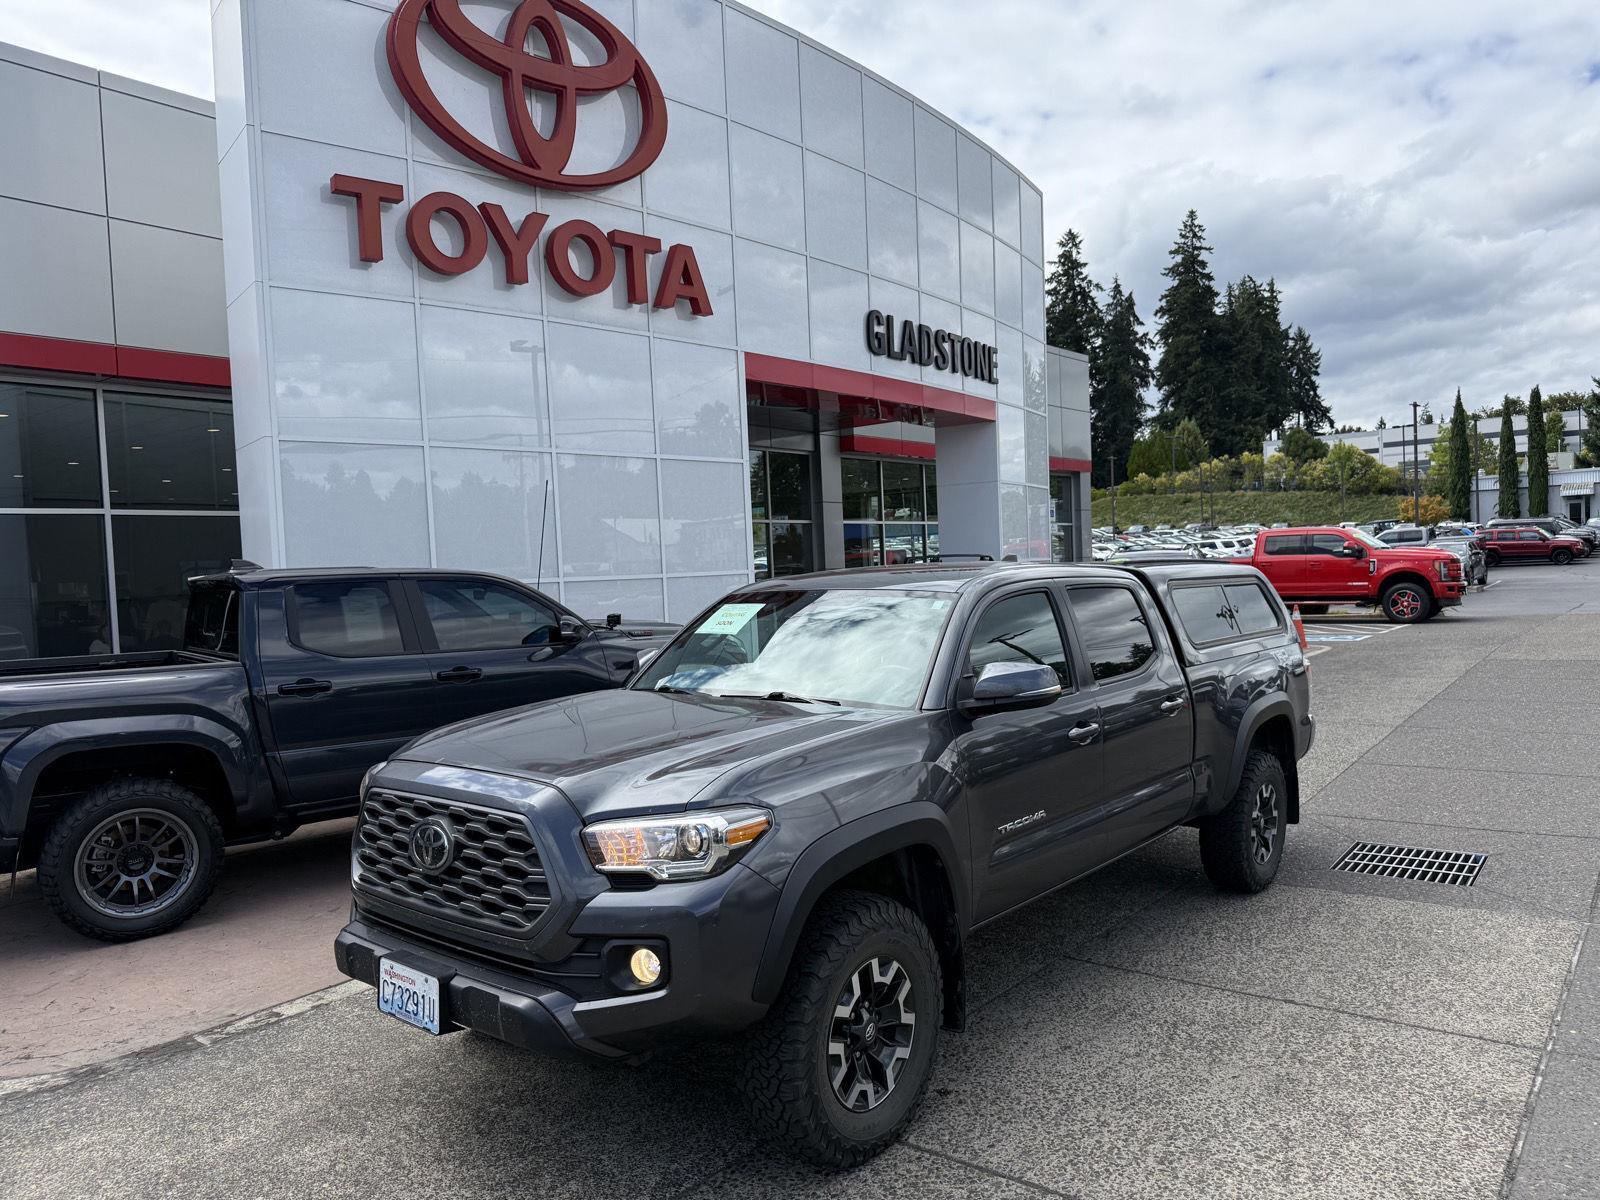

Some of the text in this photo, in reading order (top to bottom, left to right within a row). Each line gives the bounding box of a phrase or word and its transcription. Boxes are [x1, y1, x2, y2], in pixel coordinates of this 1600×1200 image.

[330, 173, 713, 317] TOYOTA
[866, 309, 999, 385] GLADSTONE
[997, 809, 1047, 834] TACOMA
[382, 979, 435, 1023] C73291U
